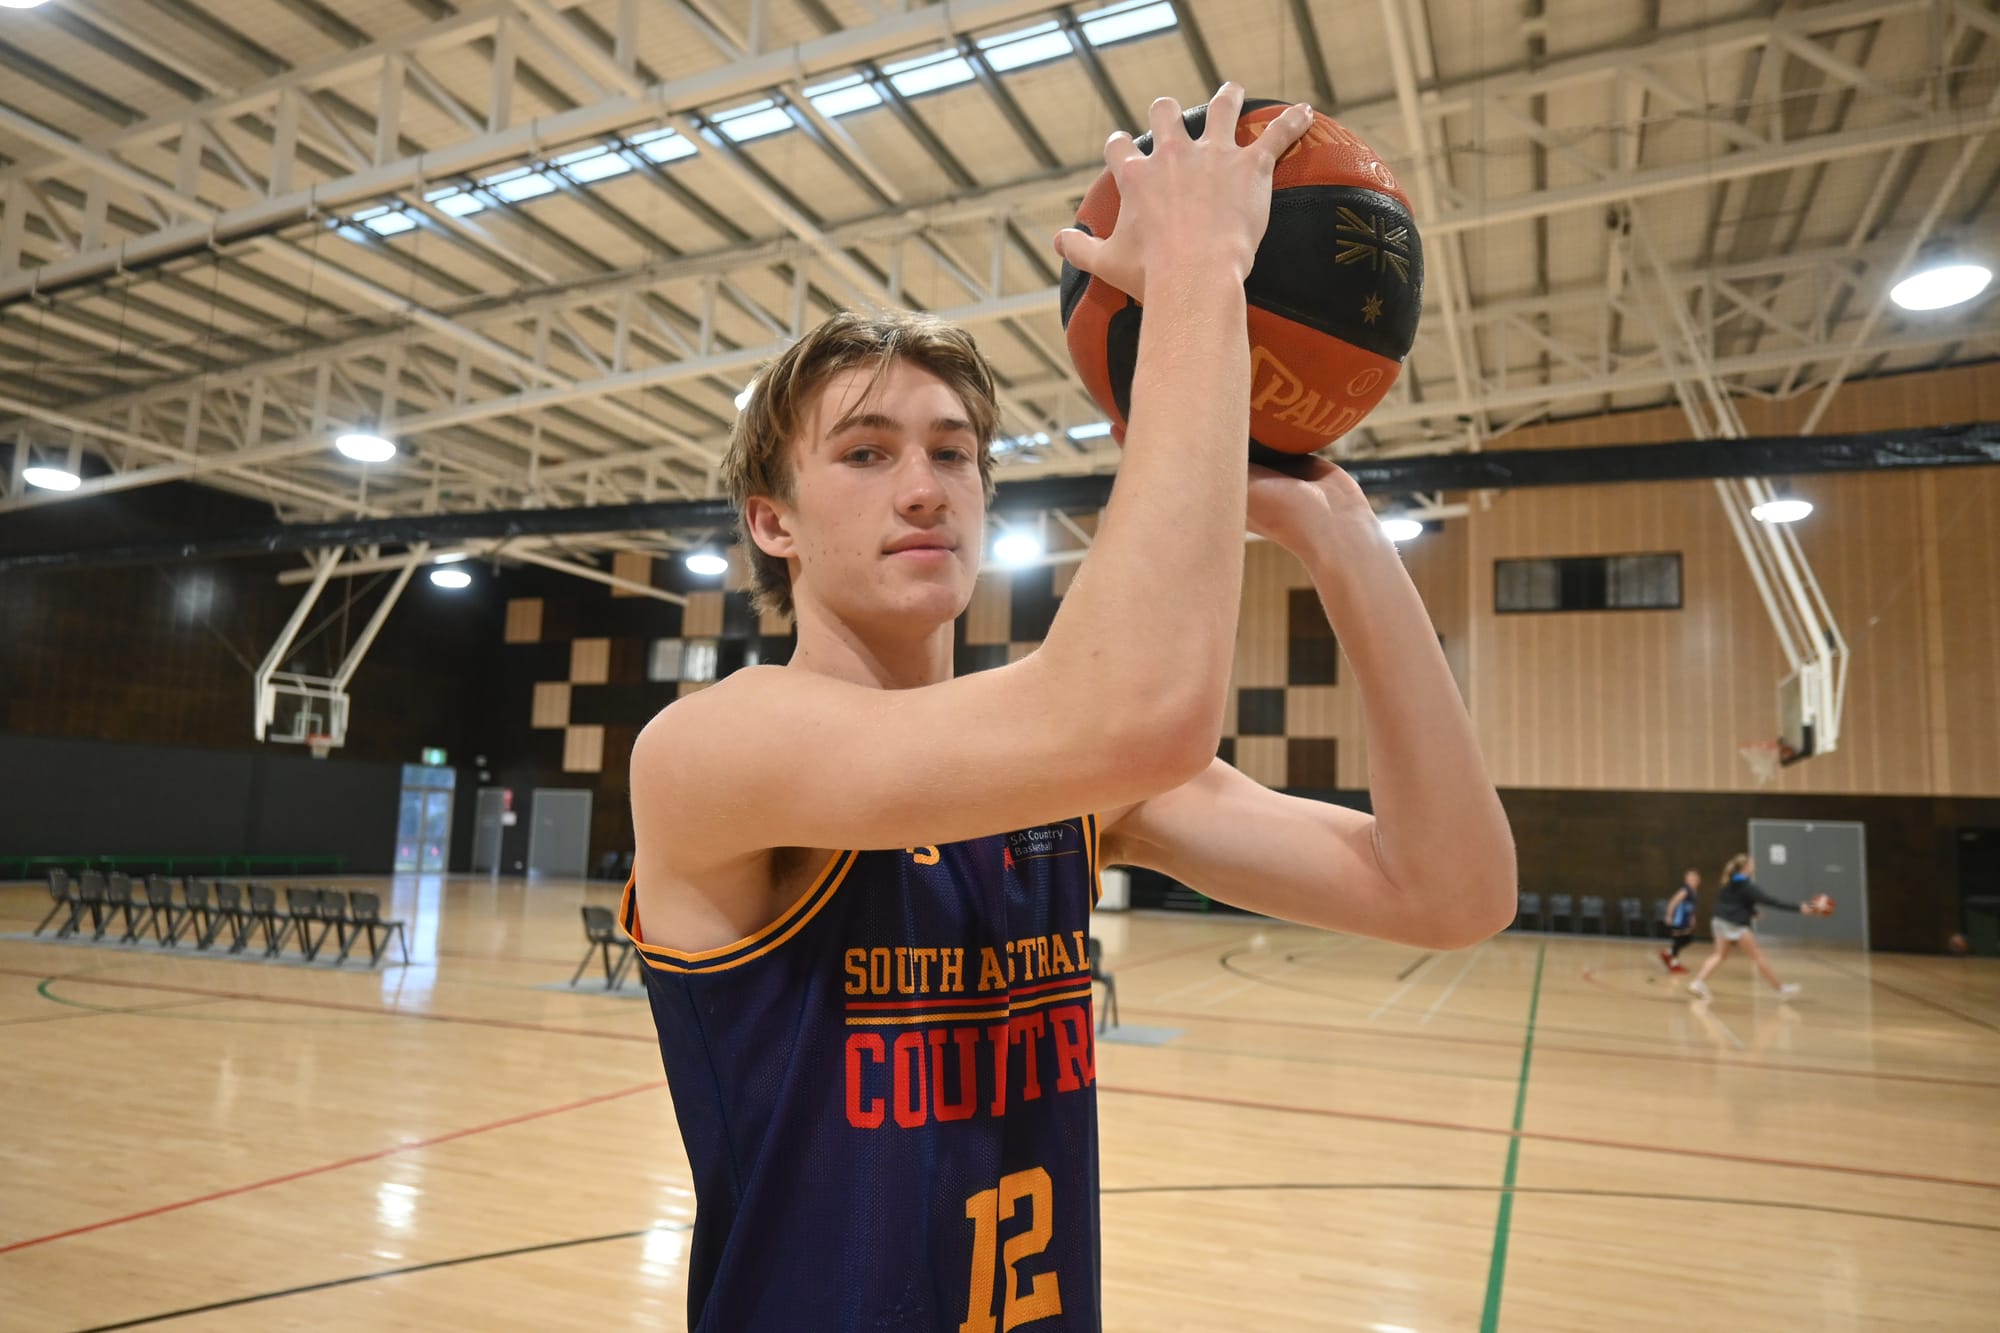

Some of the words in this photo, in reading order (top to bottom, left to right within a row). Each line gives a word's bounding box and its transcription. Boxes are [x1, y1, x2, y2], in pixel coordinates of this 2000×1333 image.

[1010, 832, 1028, 846] SA
[1028, 829, 1064, 841] Country
[845, 947, 965, 995] SOUTH
[845, 1000, 1096, 1129] COUTR
[959, 1166, 1063, 1333] 12
